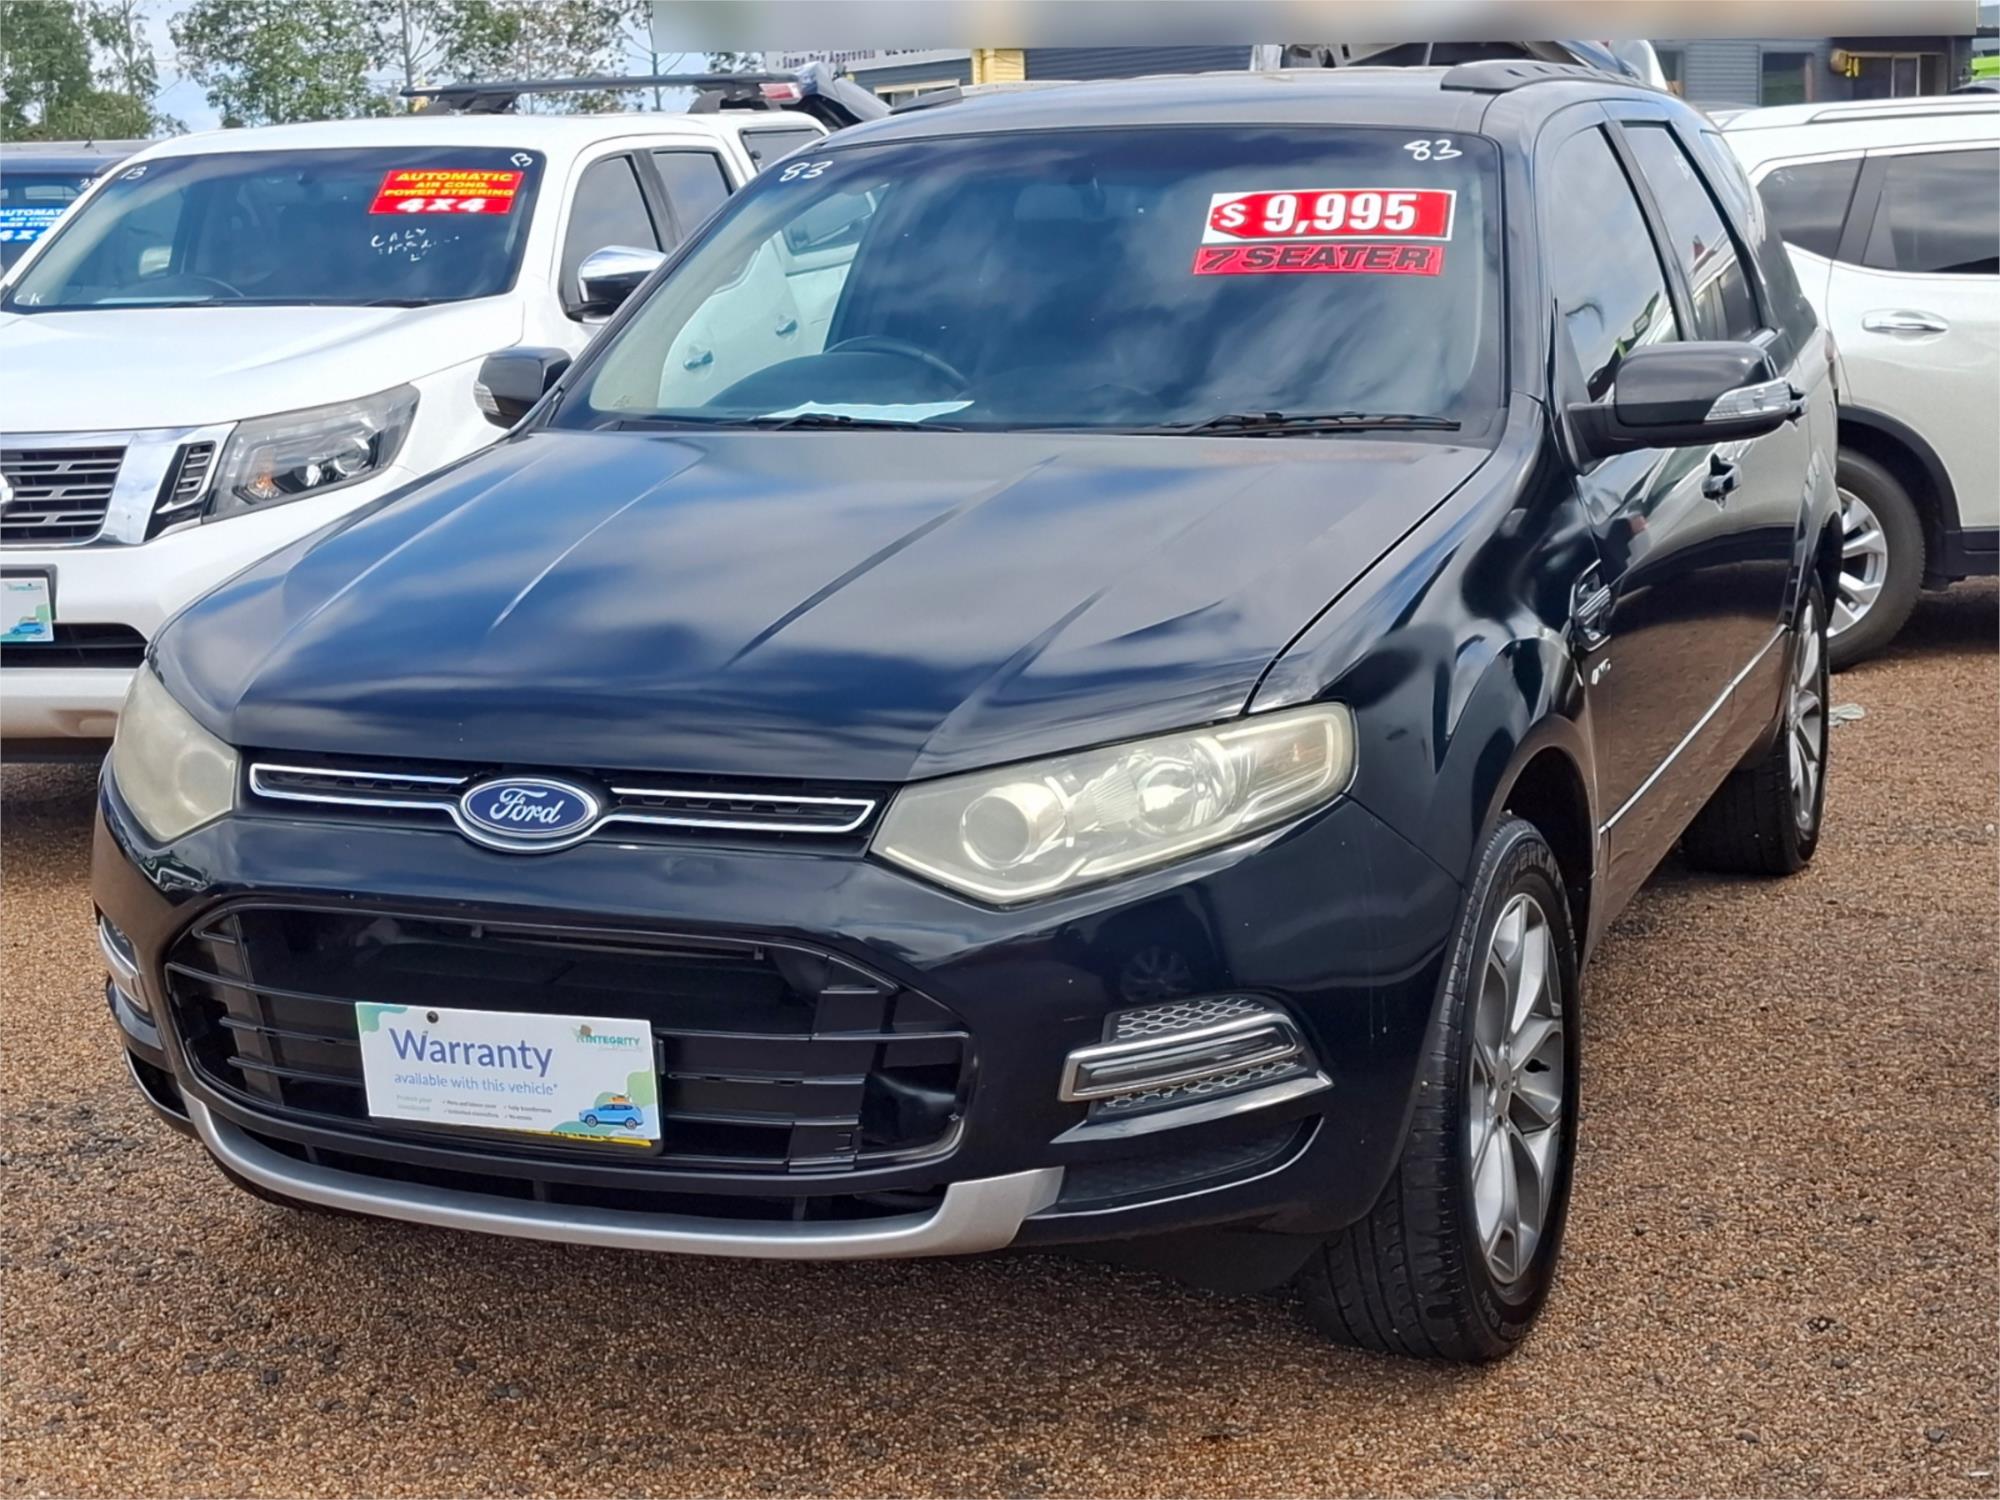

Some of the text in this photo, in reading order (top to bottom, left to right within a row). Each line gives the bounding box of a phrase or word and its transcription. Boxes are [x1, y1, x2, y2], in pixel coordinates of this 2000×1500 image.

[1403, 138, 1463, 161] 83
[395, 172, 514, 183] AUTOMATIC
[778, 160, 833, 183] 83
[383, 188, 515, 197] POWER STEERING
[415, 181, 441, 189] AIR
[0, 208, 66, 217] AUTOMAT
[1218, 192, 1418, 235] $ 9,995
[1201, 246, 1436, 272] 7 SEATER
[489, 787, 565, 825] Ford
[388, 1027, 553, 1078] Warranty
[394, 1072, 448, 1088] available
[450, 1077, 479, 1091] with
[483, 1079, 505, 1093] this
